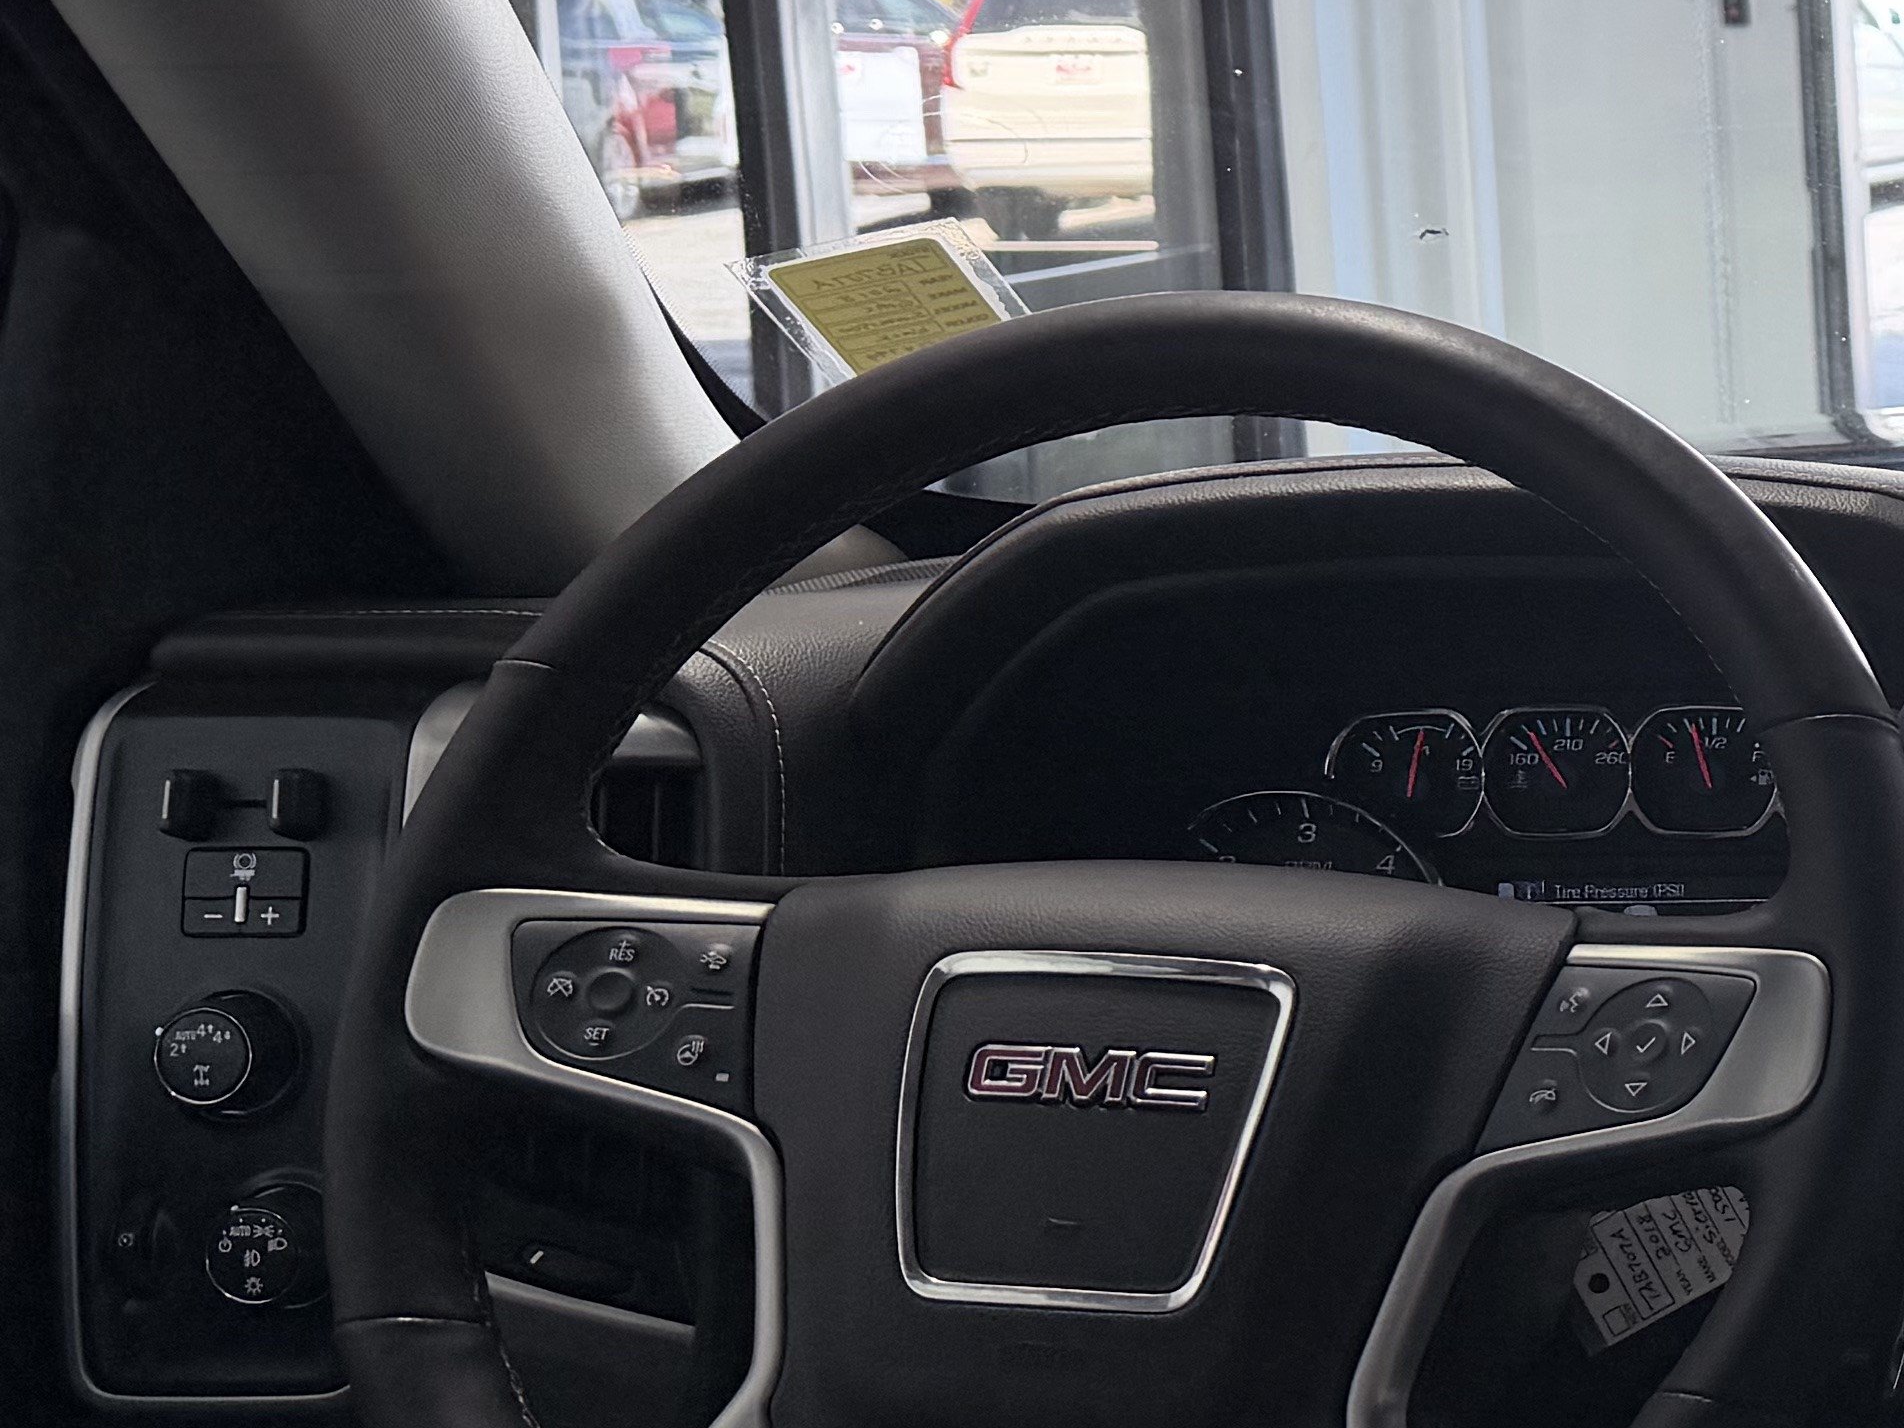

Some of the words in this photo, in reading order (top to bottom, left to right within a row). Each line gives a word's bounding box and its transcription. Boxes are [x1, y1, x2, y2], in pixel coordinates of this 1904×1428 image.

[1553, 738, 1584, 751] 210
[1456, 758, 1474, 771] 19
[1509, 753, 1540, 765] 160
[1665, 751, 1676, 764] E
[1371, 758, 1384, 773] 9
[1297, 822, 1318, 843] 3
[1375, 854, 1396, 875] 4
[1555, 884, 1581, 899] Tire
[1584, 884, 1649, 900] Pressure
[608, 948, 636, 962] RES
[583, 1026, 610, 1041] SET
[966, 1043, 1215, 1112] GMC
